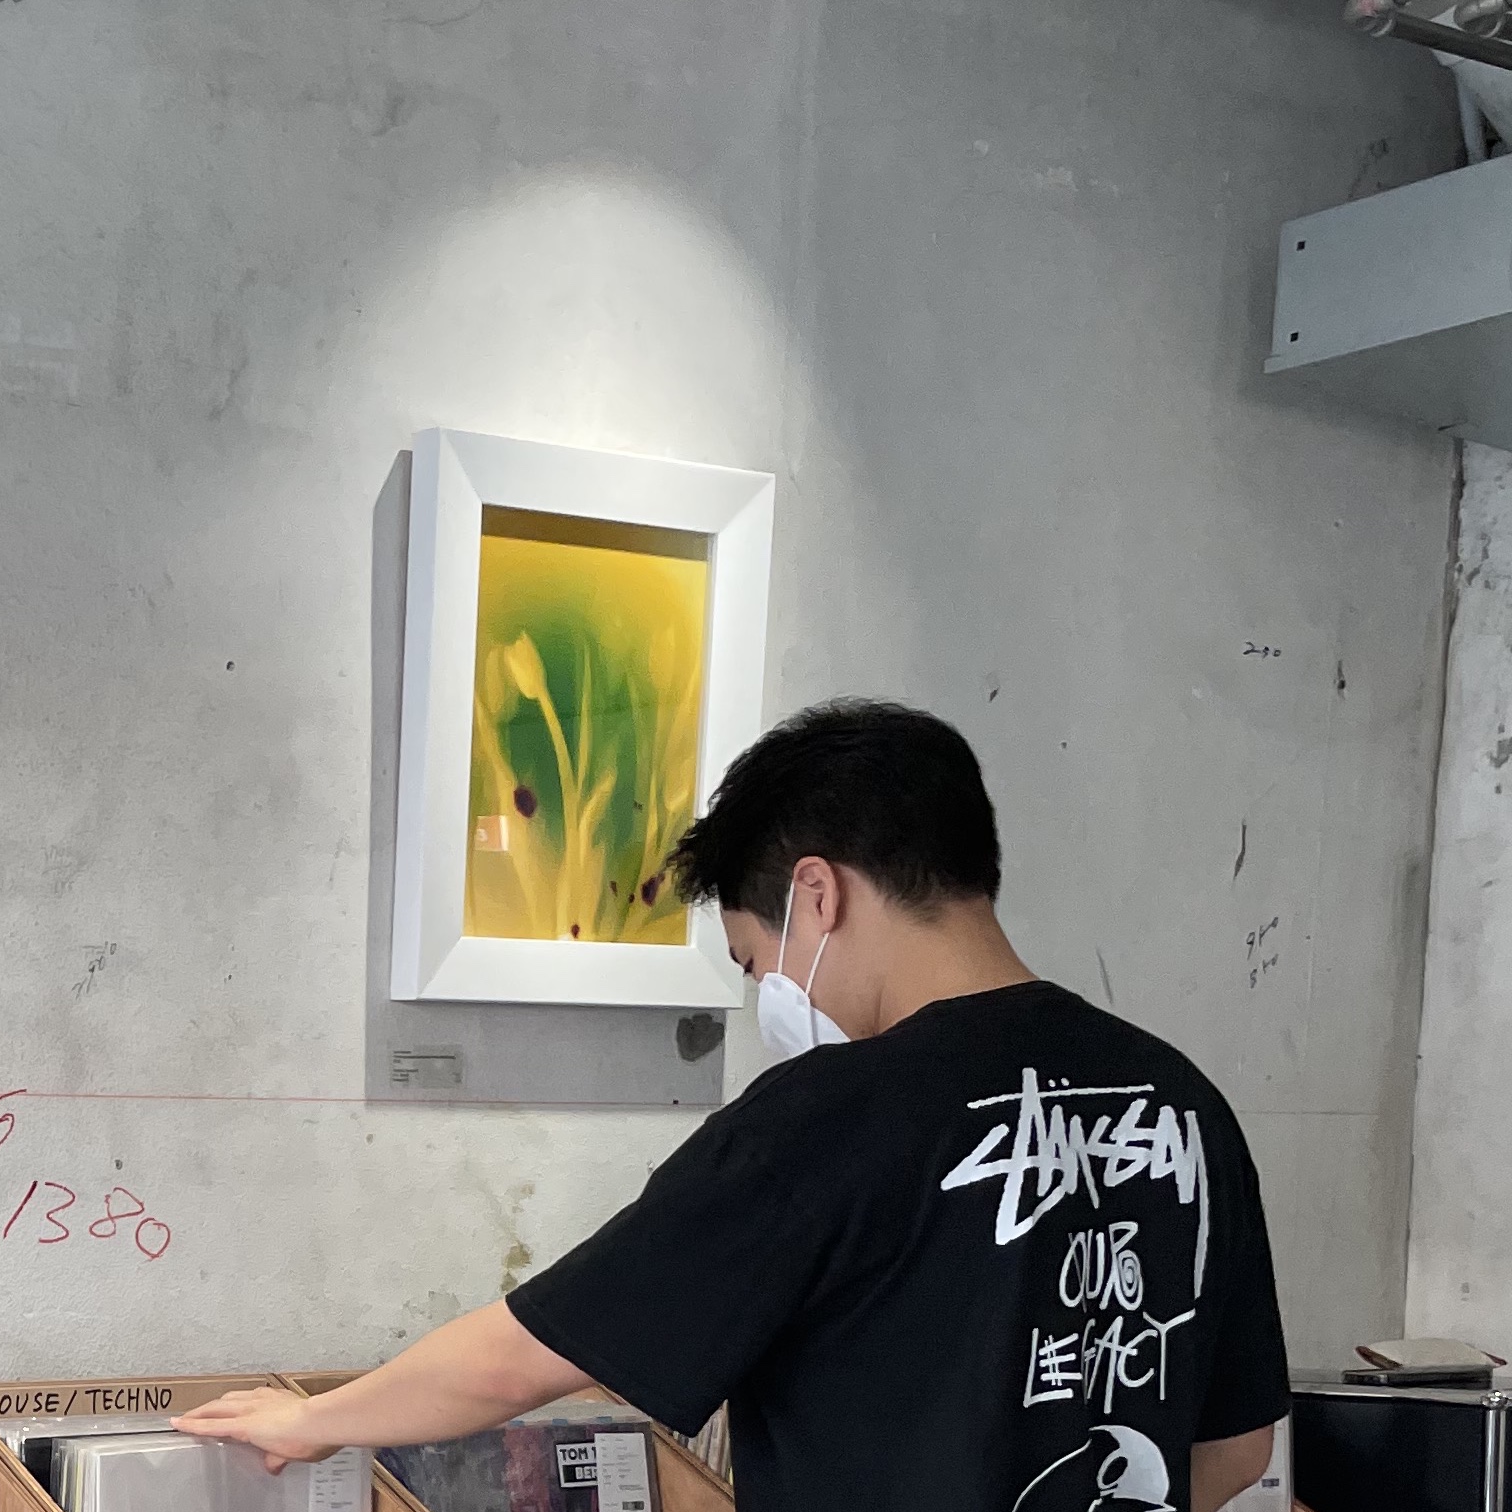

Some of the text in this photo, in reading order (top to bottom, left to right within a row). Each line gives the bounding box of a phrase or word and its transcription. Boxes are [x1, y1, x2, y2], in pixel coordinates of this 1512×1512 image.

[2, 1179, 171, 1260] 1380
[84, 1386, 173, 1415] TECHNO
[559, 1447, 589, 1461] TOM
